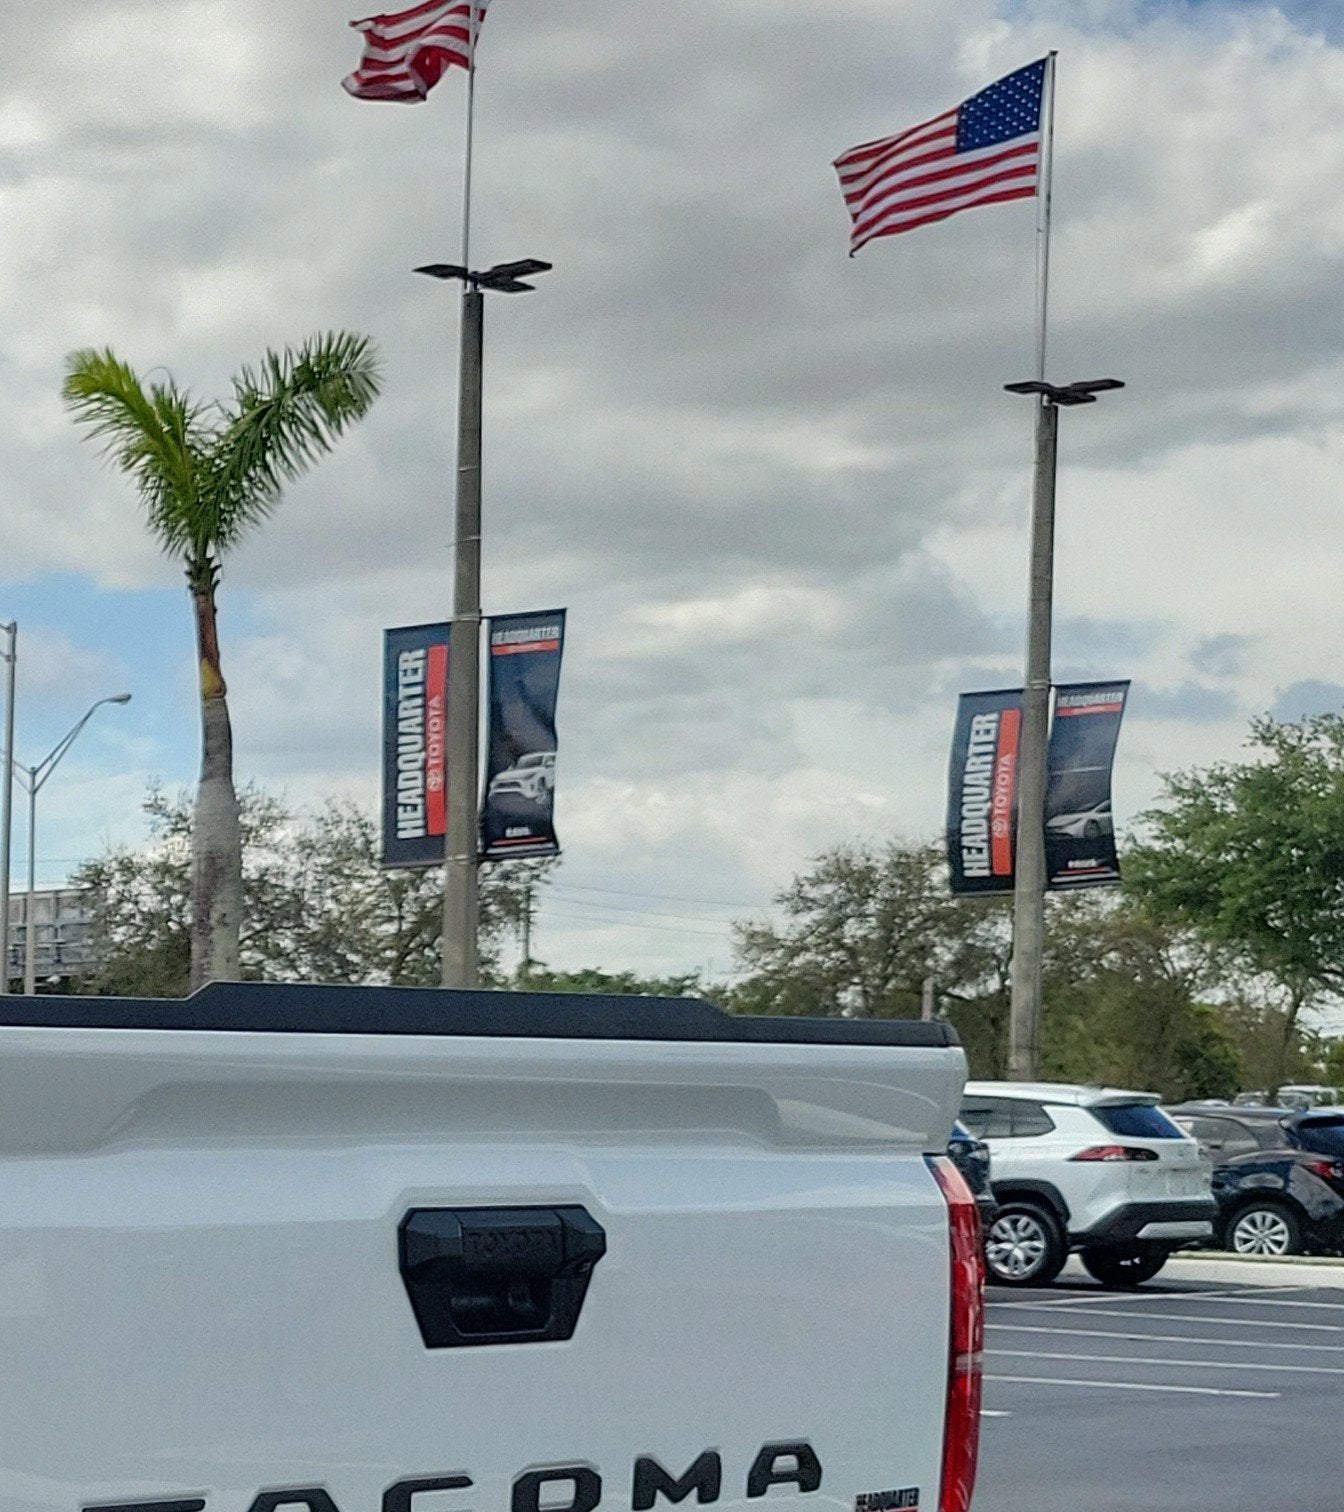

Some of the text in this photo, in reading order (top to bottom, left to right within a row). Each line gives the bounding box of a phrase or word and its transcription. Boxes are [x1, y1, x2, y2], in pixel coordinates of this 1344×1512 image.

[397, 648, 426, 840] HEADQUARTER
[427, 695, 445, 767] TOYOTA
[994, 753, 1016, 817] TOYOTA
[962, 712, 999, 877] HEADQUARTER
